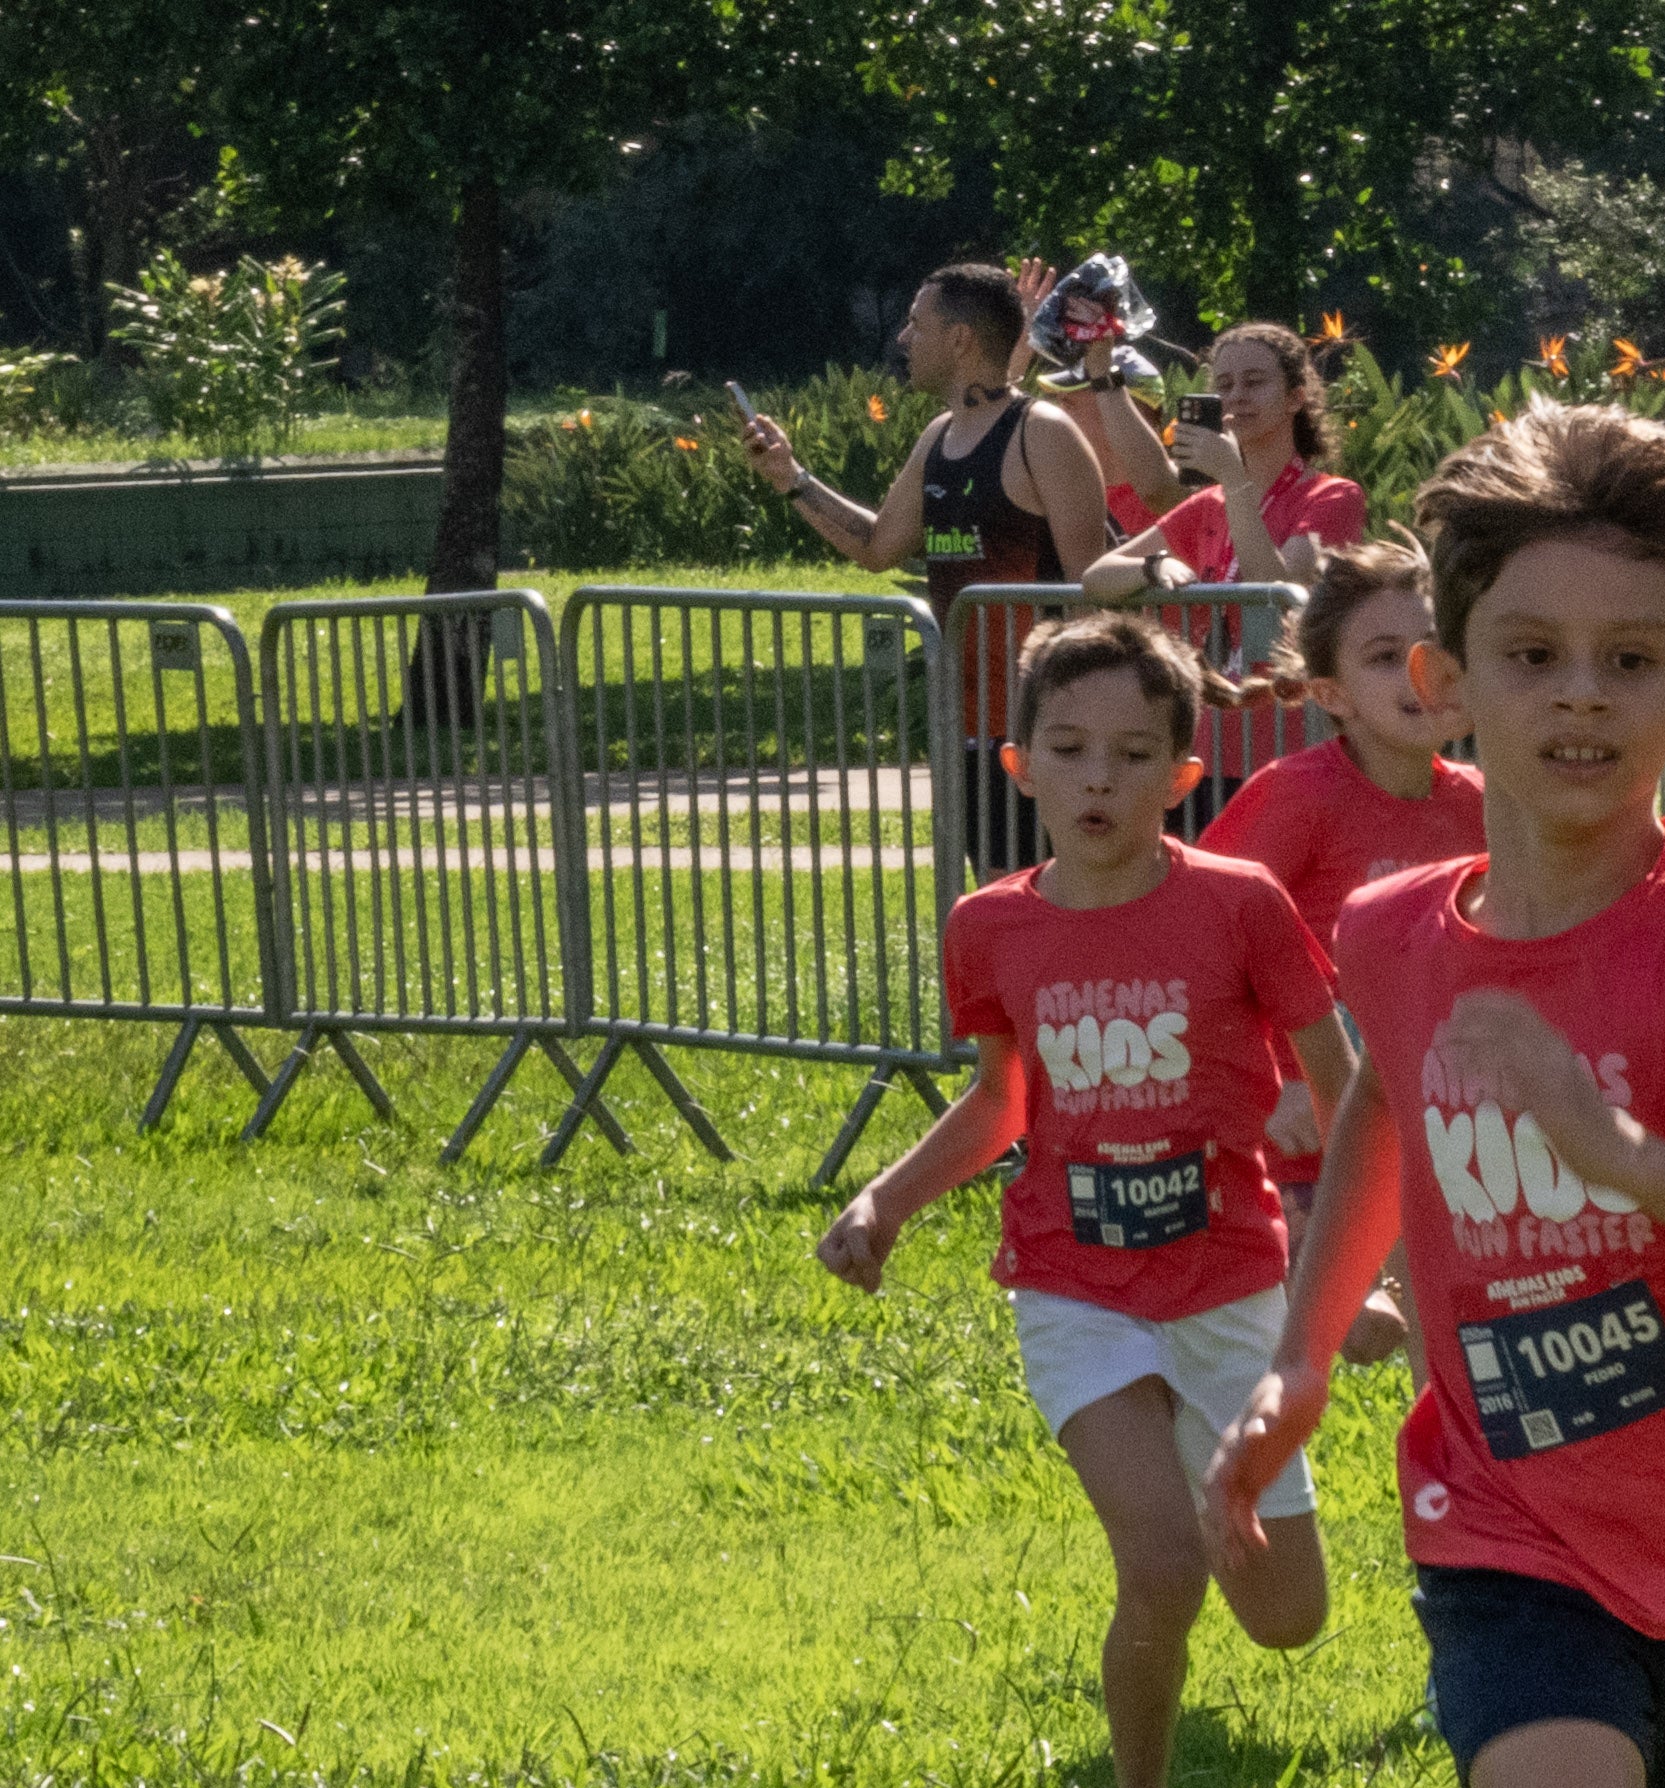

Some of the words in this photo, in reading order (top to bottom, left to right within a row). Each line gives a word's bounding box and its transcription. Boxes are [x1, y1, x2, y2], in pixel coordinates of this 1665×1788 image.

[1036, 978, 1189, 1023] ATHENAS
[1037, 1011, 1191, 1091] KIDS
[1110, 1164, 1199, 1207] 10042
[1424, 1100, 1640, 1224] KID
[1519, 1212, 1656, 1258] FASTER
[1517, 1301, 1659, 1379] 10045
